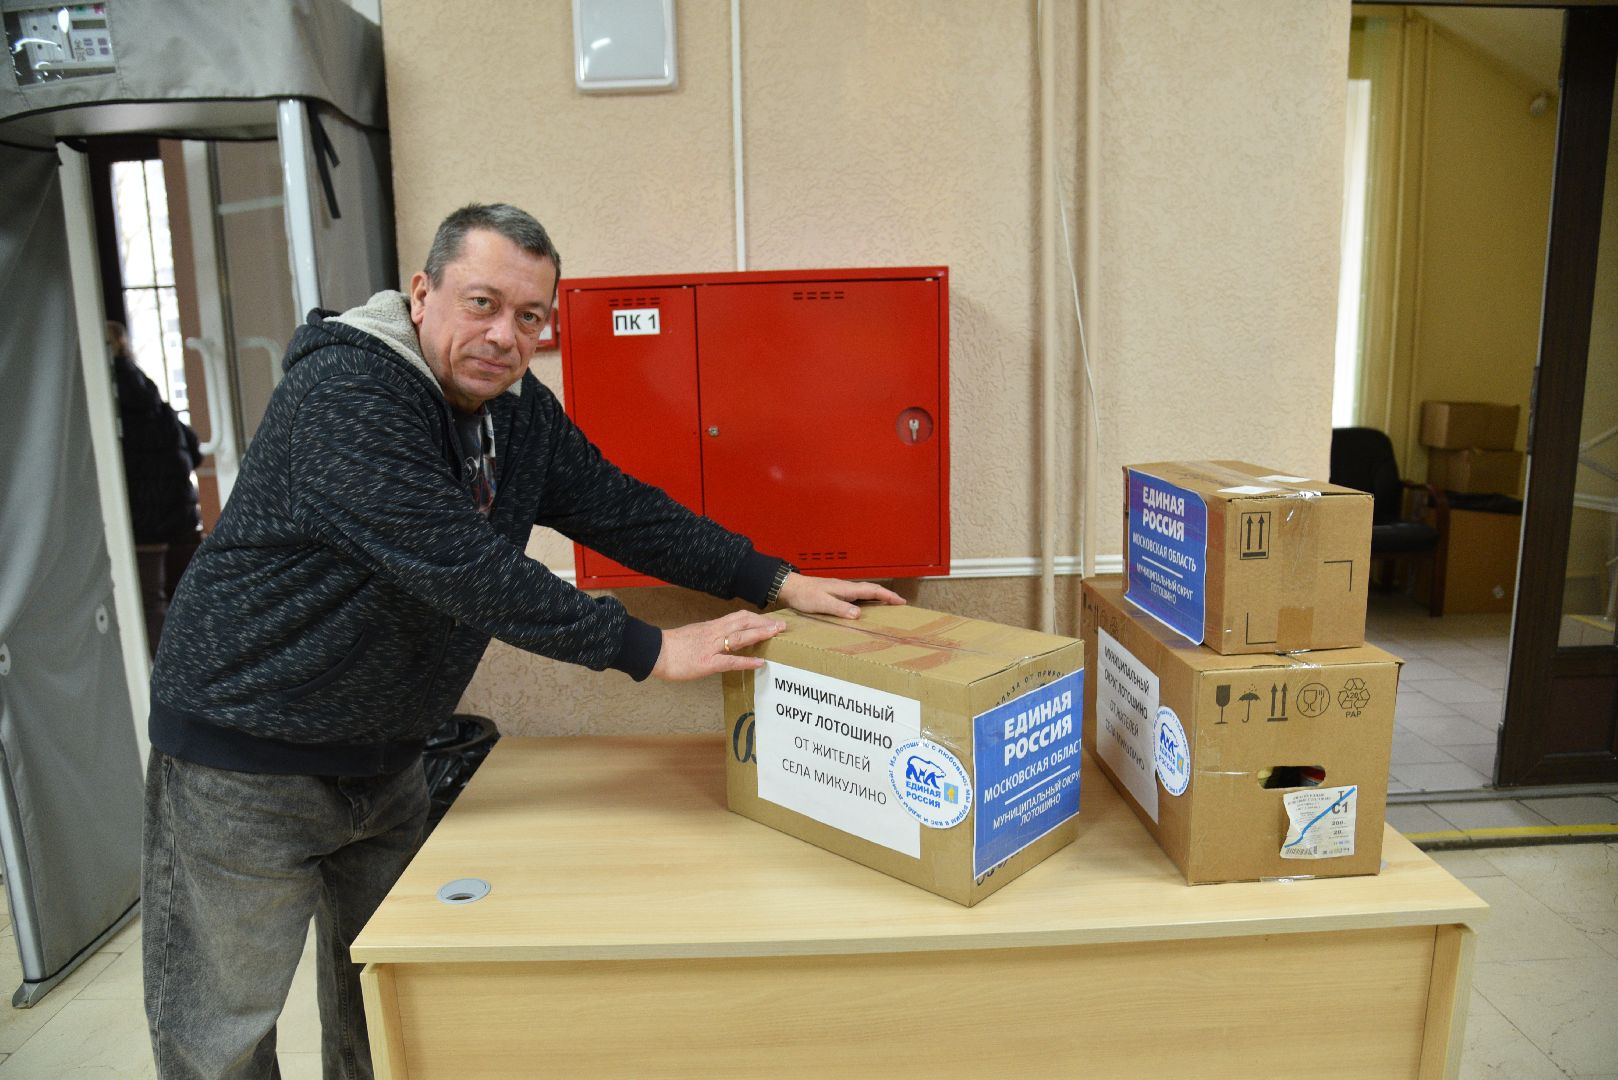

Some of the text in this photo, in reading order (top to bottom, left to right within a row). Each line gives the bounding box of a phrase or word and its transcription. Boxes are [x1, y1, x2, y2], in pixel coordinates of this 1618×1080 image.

[615, 313, 656, 330] ПК 1
[1142, 486, 1185, 517] ЕДИНАЯ
[1142, 508, 1185, 542] РОССИЯ
[1132, 531, 1197, 572] МОСКОВСКАЯ ОБЛАСТЬ
[775, 678, 894, 723] МУНИЦИПАЛЬНЫЙ
[1003, 689, 1072, 741] ЕДИНАЯ
[1345, 710, 1361, 719] PAP
[776, 703, 893, 749] ОКРУГ ЛОТОШИНО
[1004, 713, 1073, 767] РОССИЯ
[794, 736, 871, 773] ОТ ЖИТЕЛЕЙ
[984, 738, 1082, 804] МОСКОВСКАЯ ОБЛАСТ
[782, 758, 887, 805] СЕЛА МИКУЛИНО
[905, 781, 942, 799] ЕДИНАЯ
[905, 790, 941, 809] РОССИЯ
[992, 767, 1082, 831] МУНИЦИПАЛЬНЫЙ ОКРУ
[1020, 793, 1061, 826] ЛОТОШИНО
